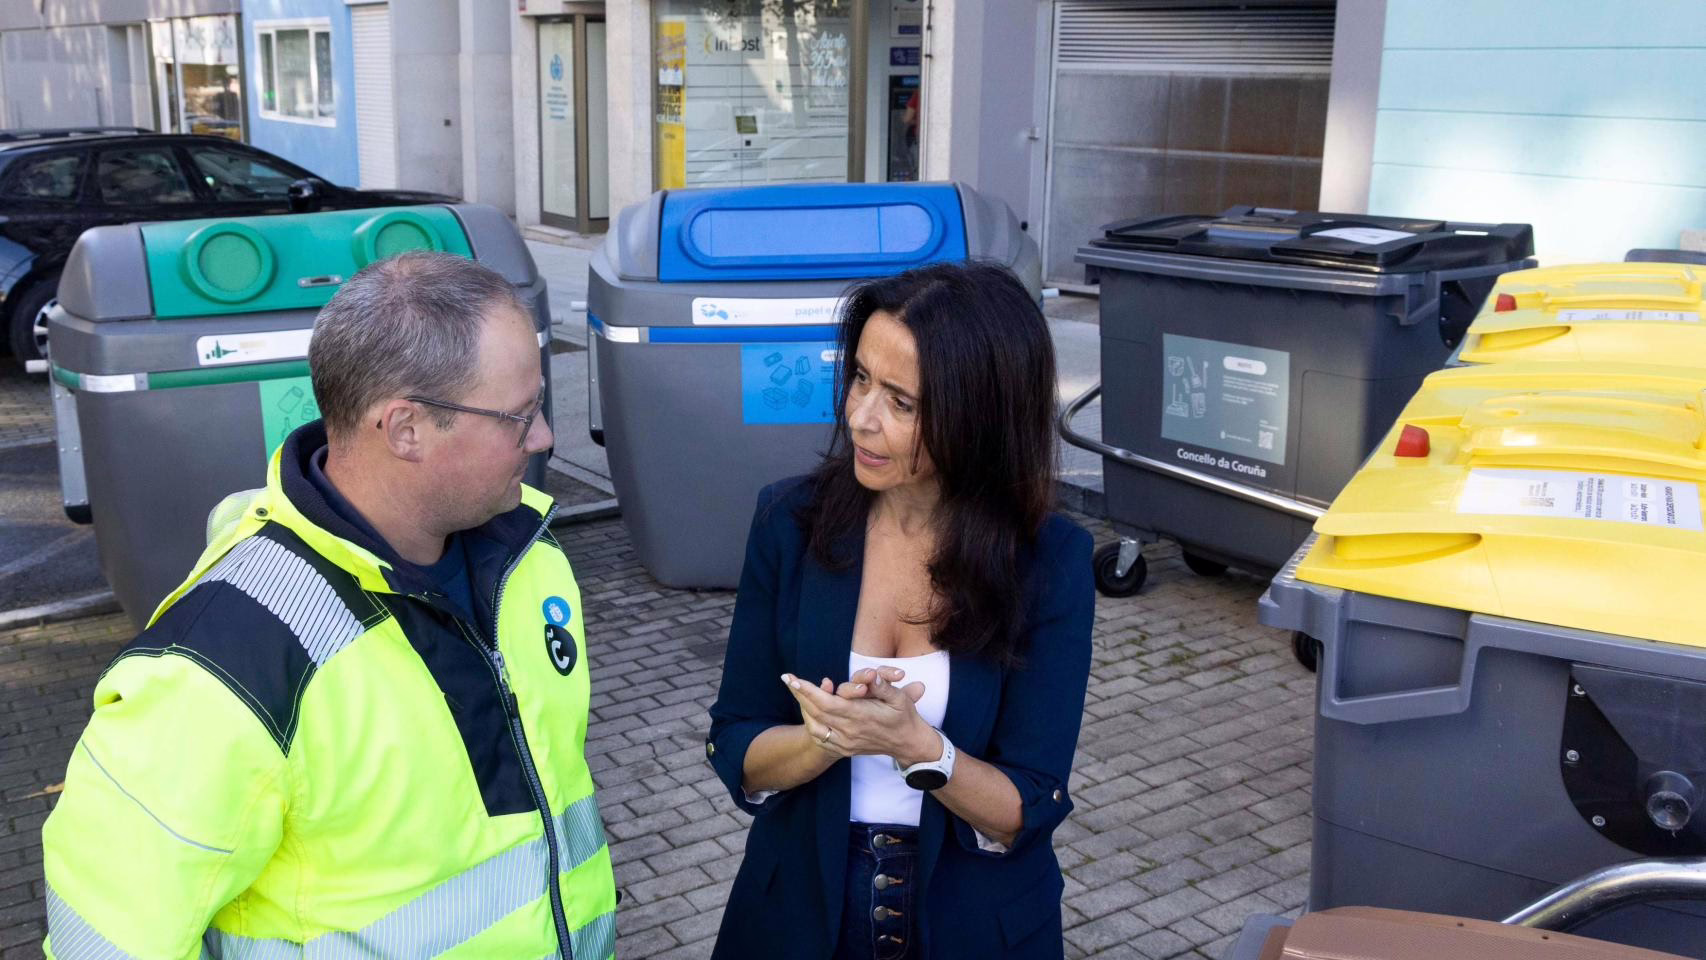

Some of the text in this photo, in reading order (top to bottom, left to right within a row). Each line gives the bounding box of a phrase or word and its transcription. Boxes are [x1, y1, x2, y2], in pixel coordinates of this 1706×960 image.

[795, 306, 823, 317] papel
[1176, 447, 1267, 478] Concello da Coruña
